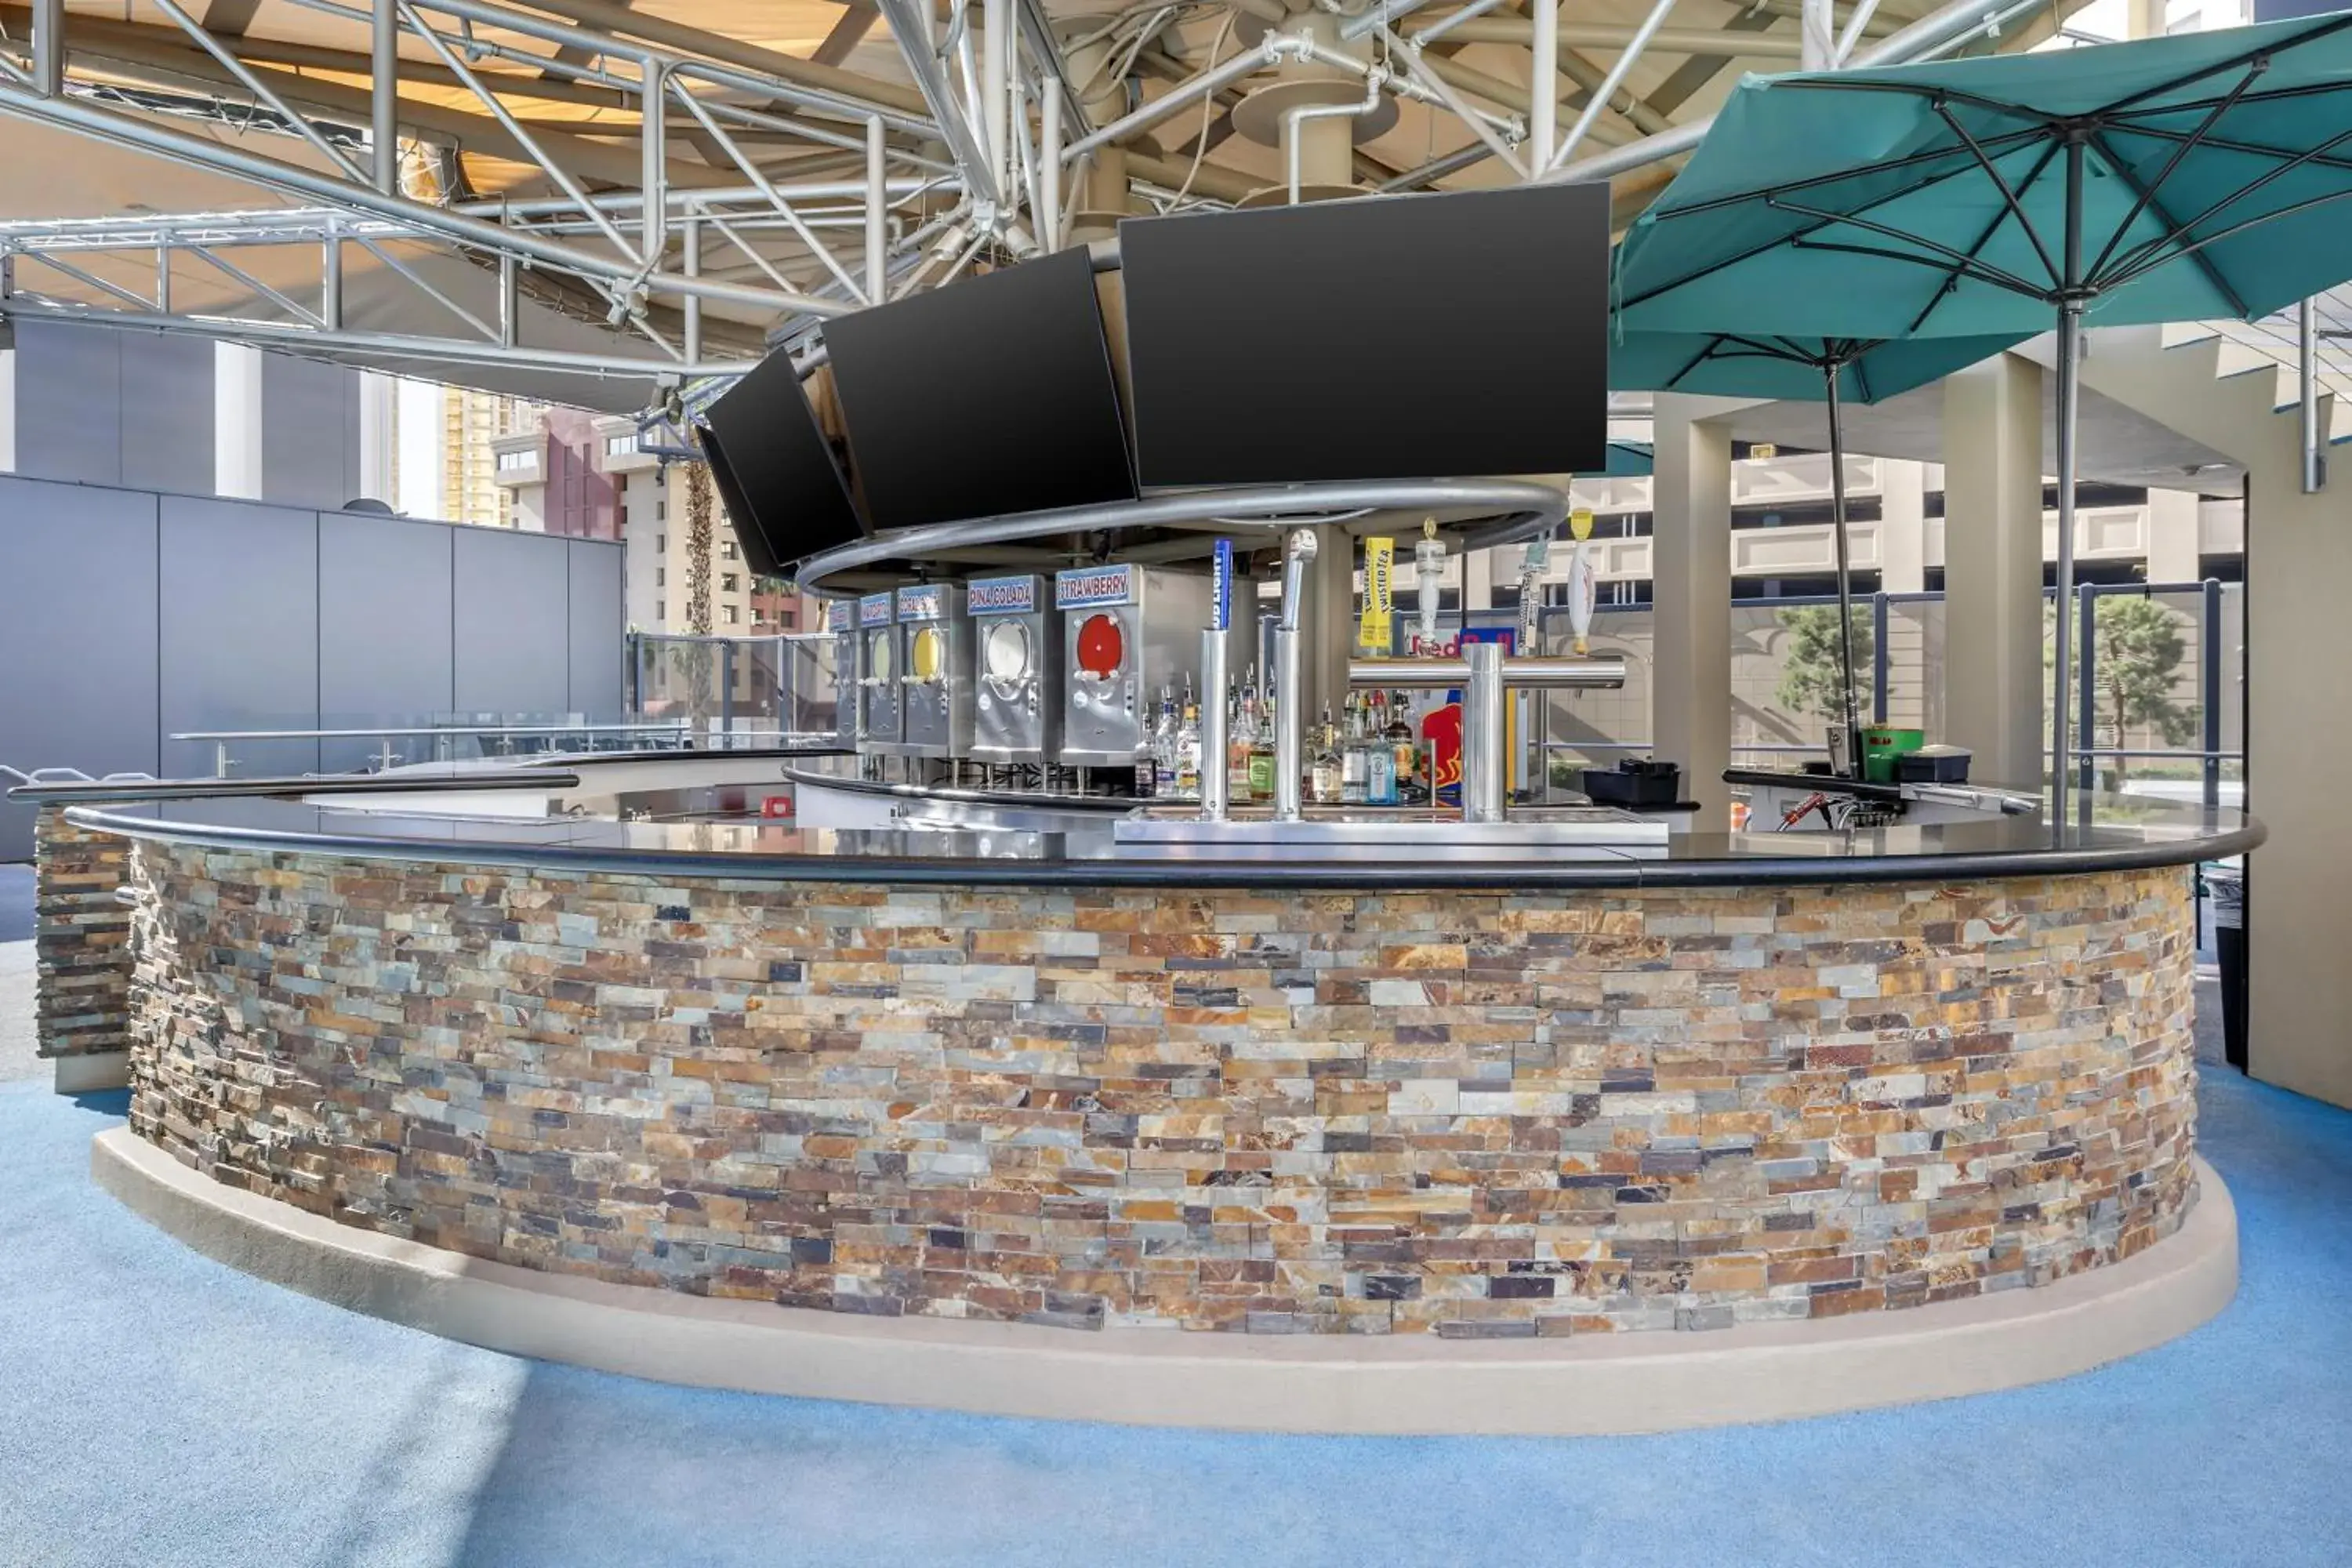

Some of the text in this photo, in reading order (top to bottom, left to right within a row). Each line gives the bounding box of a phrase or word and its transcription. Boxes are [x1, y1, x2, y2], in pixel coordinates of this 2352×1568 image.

[1377, 550, 1390, 568] TEA
[1058, 574, 1127, 599] STRAWBERRY
[1213, 554, 1221, 601] LIGHT
[993, 584, 1031, 604] COLADA
[1377, 569, 1389, 615] TWISTED
